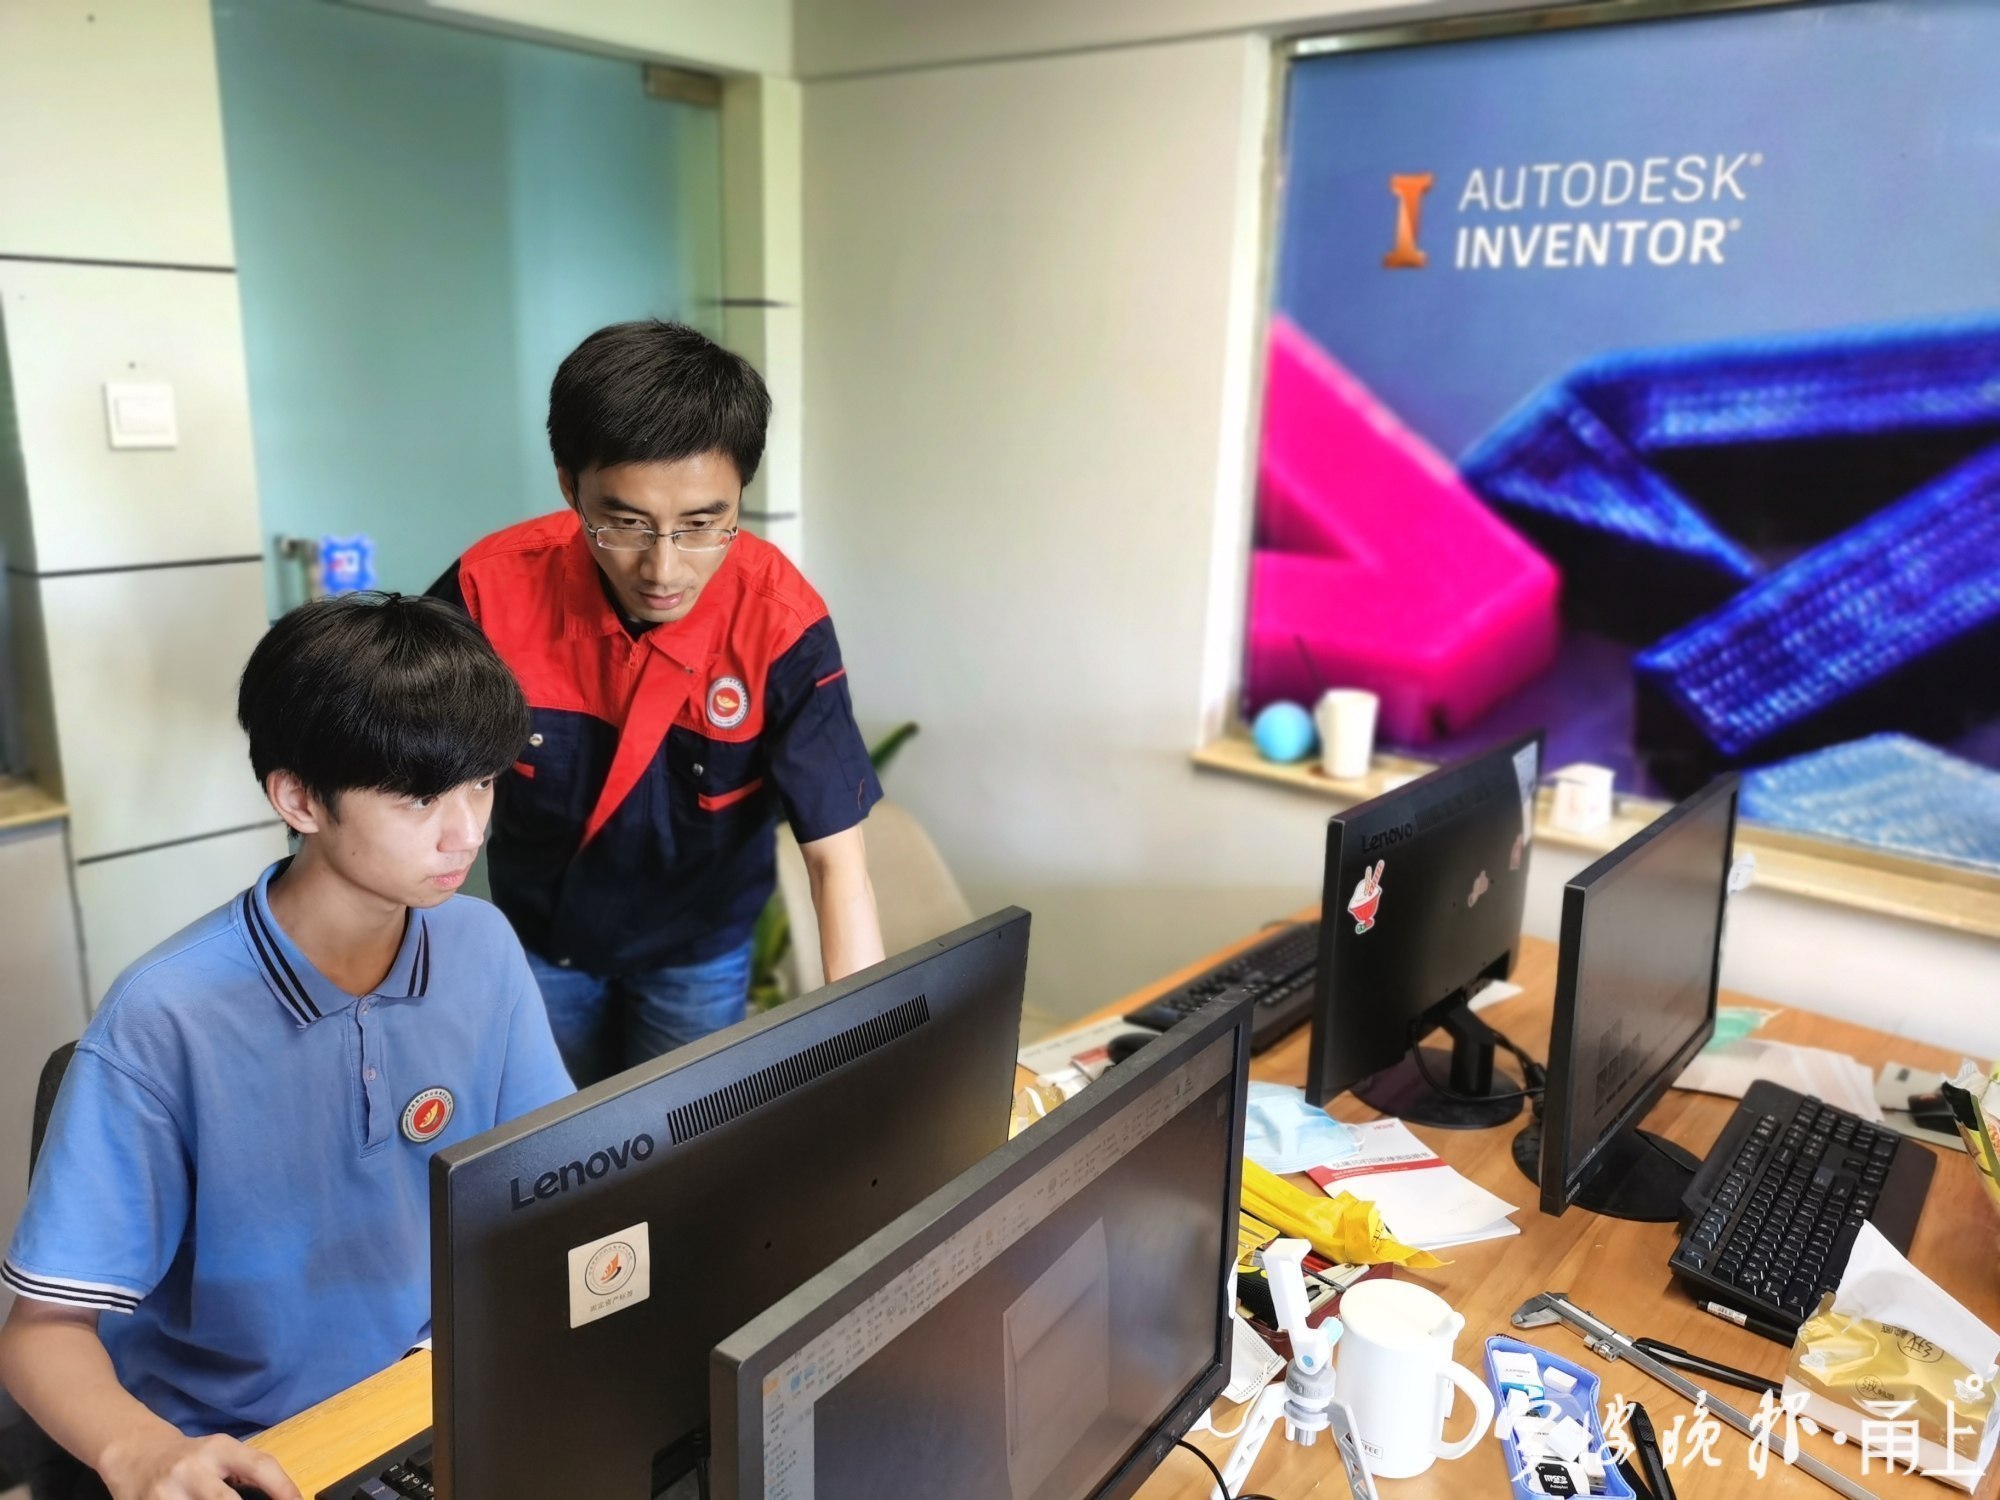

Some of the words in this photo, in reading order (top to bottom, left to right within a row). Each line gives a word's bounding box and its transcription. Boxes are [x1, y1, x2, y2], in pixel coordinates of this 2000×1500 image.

[1457, 152, 1748, 212] AUTODESK
[1455, 217, 1727, 270] INVENTOR
[1361, 822, 1413, 854] Lenovo
[510, 1133, 655, 1211] Lenovo
